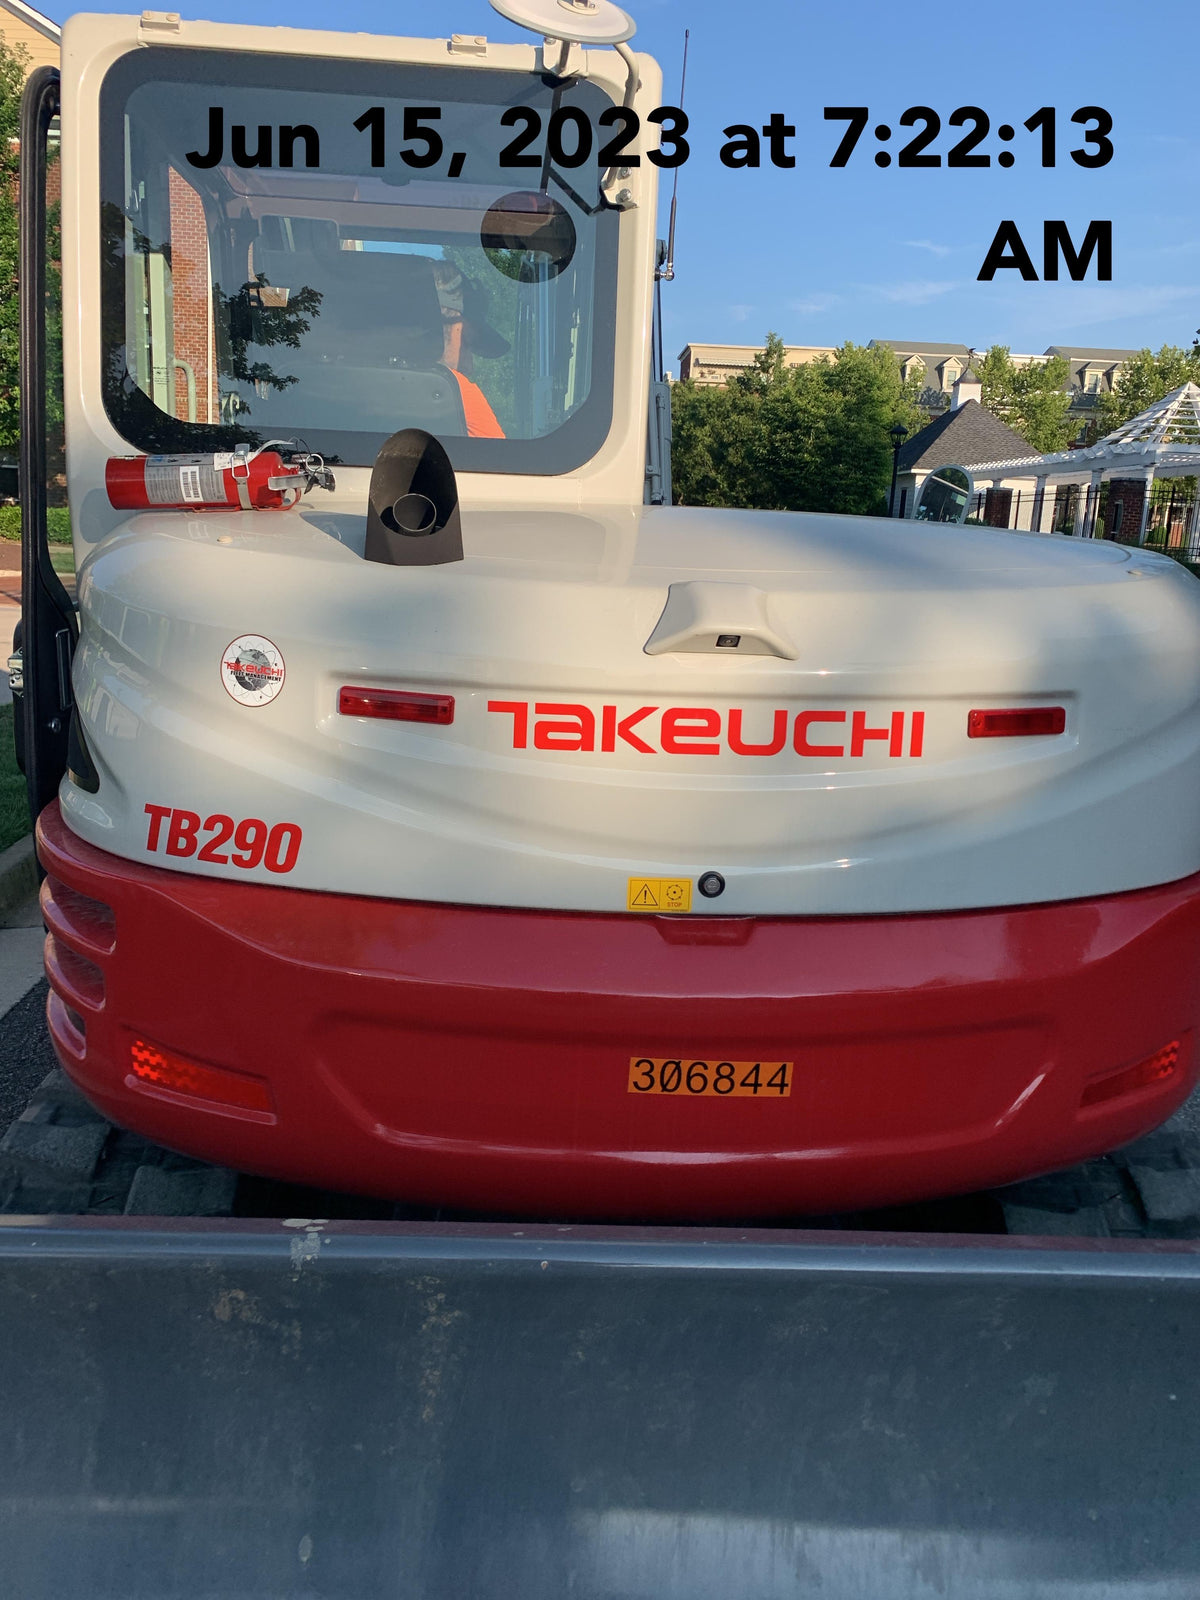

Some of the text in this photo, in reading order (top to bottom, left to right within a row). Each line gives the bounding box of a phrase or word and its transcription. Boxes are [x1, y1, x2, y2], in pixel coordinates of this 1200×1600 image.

[245, 672, 281, 681] MANAGEMENT
[144, 803, 303, 874] TB290
[632, 1058, 789, 1095] 306844
